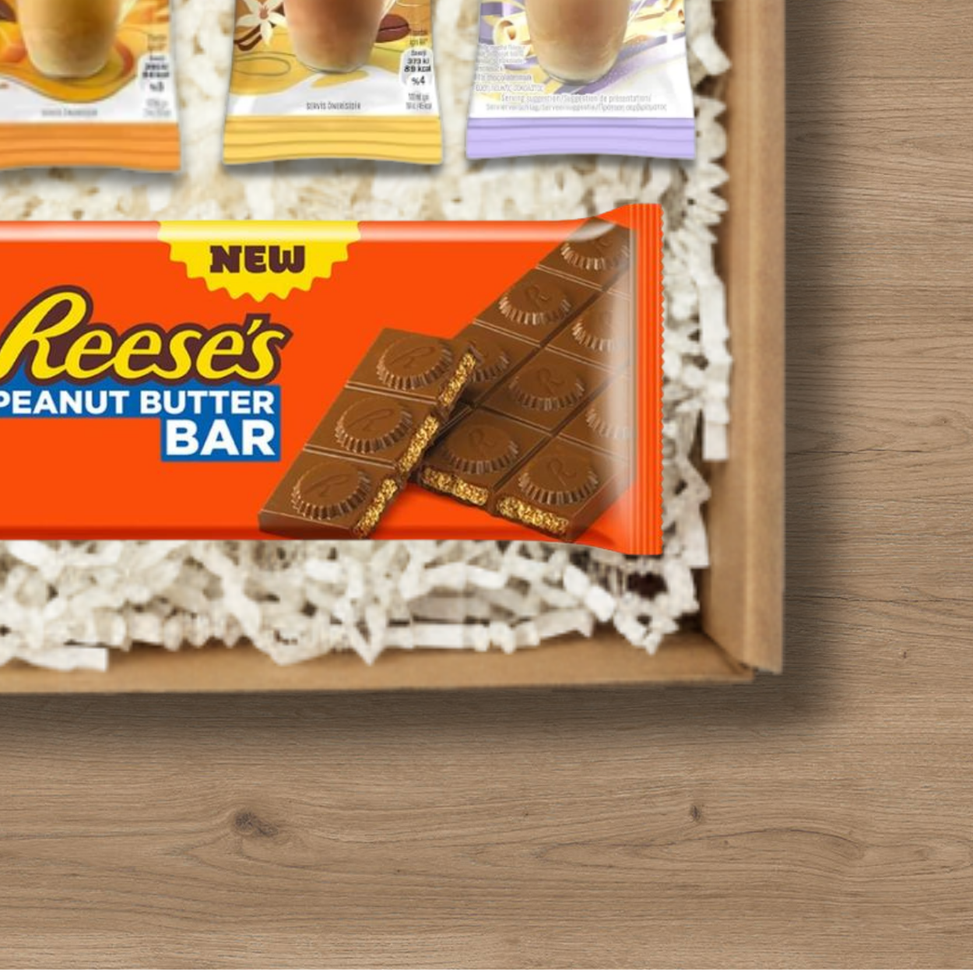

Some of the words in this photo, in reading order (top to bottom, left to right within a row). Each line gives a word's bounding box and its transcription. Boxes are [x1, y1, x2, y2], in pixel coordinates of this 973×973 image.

[209, 245, 306, 275] NEW
[139, 391, 275, 415] BUTTER
[164, 419, 276, 457] BAR
